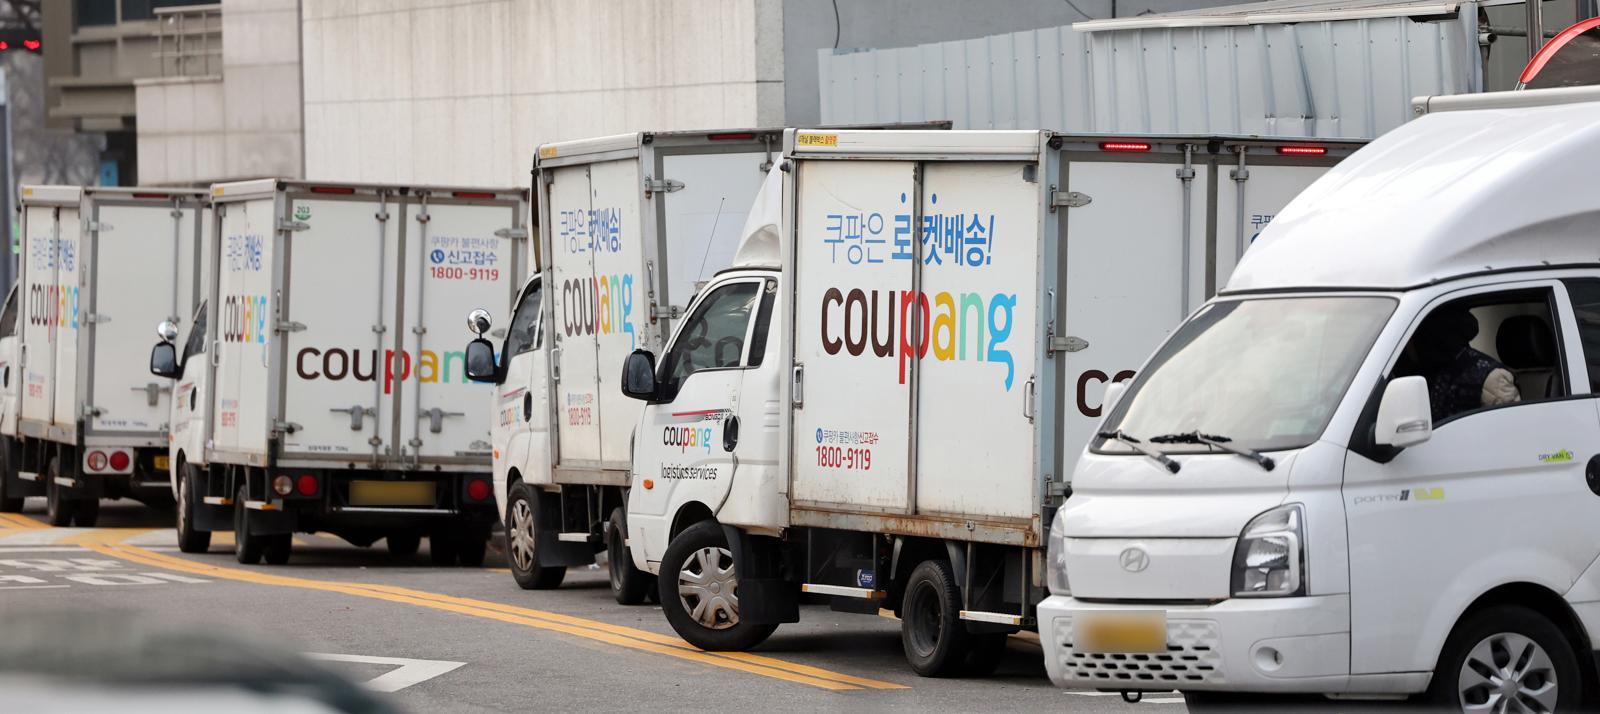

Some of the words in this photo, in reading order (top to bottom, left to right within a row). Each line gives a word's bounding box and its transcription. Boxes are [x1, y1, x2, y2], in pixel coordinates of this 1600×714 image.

[560, 208, 586, 254] 쿠팡은
[824, 212, 886, 265] 쿠팡은
[448, 250, 497, 265] 신고접수
[431, 267, 499, 281] 1800-9119
[821, 287, 1017, 392] coupang
[296, 347, 499, 394] coupan
[663, 426, 712, 455] coupang
[661, 462, 689, 483] logistics
[689, 464, 718, 480] services
[815, 446, 871, 471] 1800-9119
